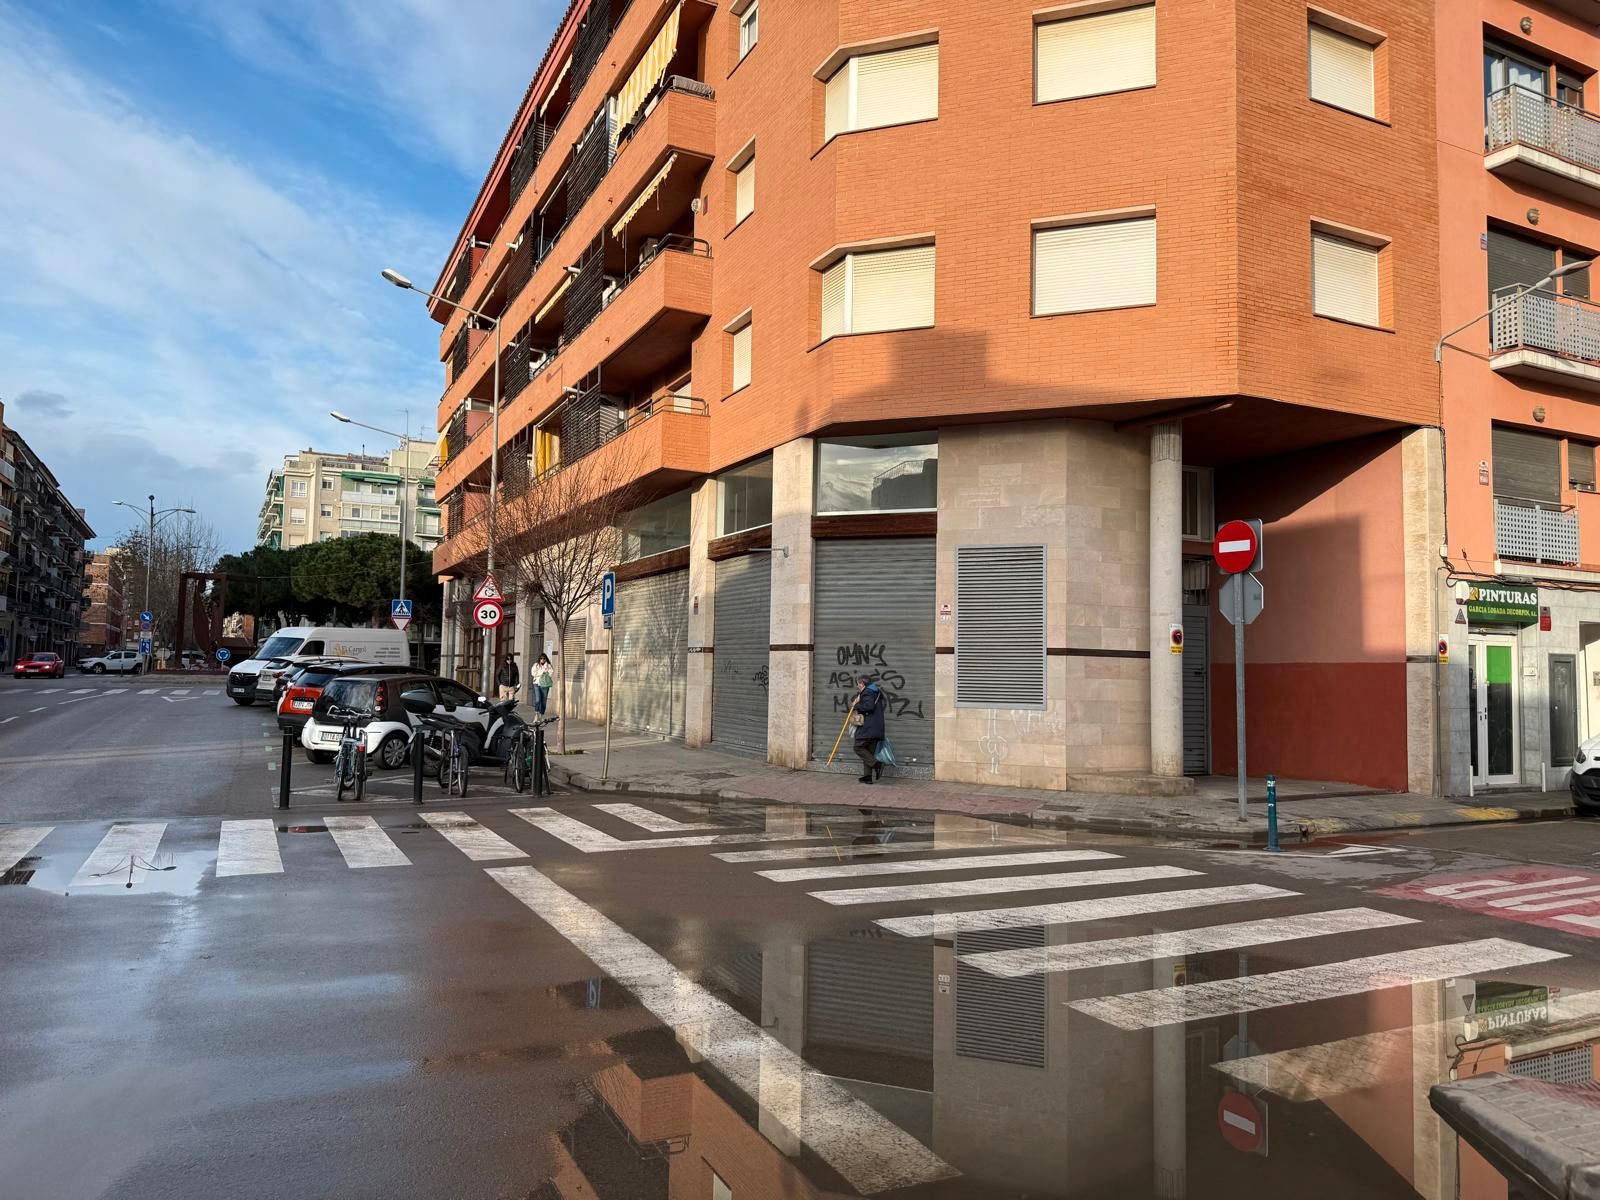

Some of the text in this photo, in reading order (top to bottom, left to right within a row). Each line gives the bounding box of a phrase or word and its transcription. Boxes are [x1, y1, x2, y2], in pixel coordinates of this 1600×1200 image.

[604, 579, 612, 610] P
[1479, 588, 1537, 605] PINTURAS
[480, 610, 497, 619] 30
[1468, 605, 1487, 614] GARCIA
